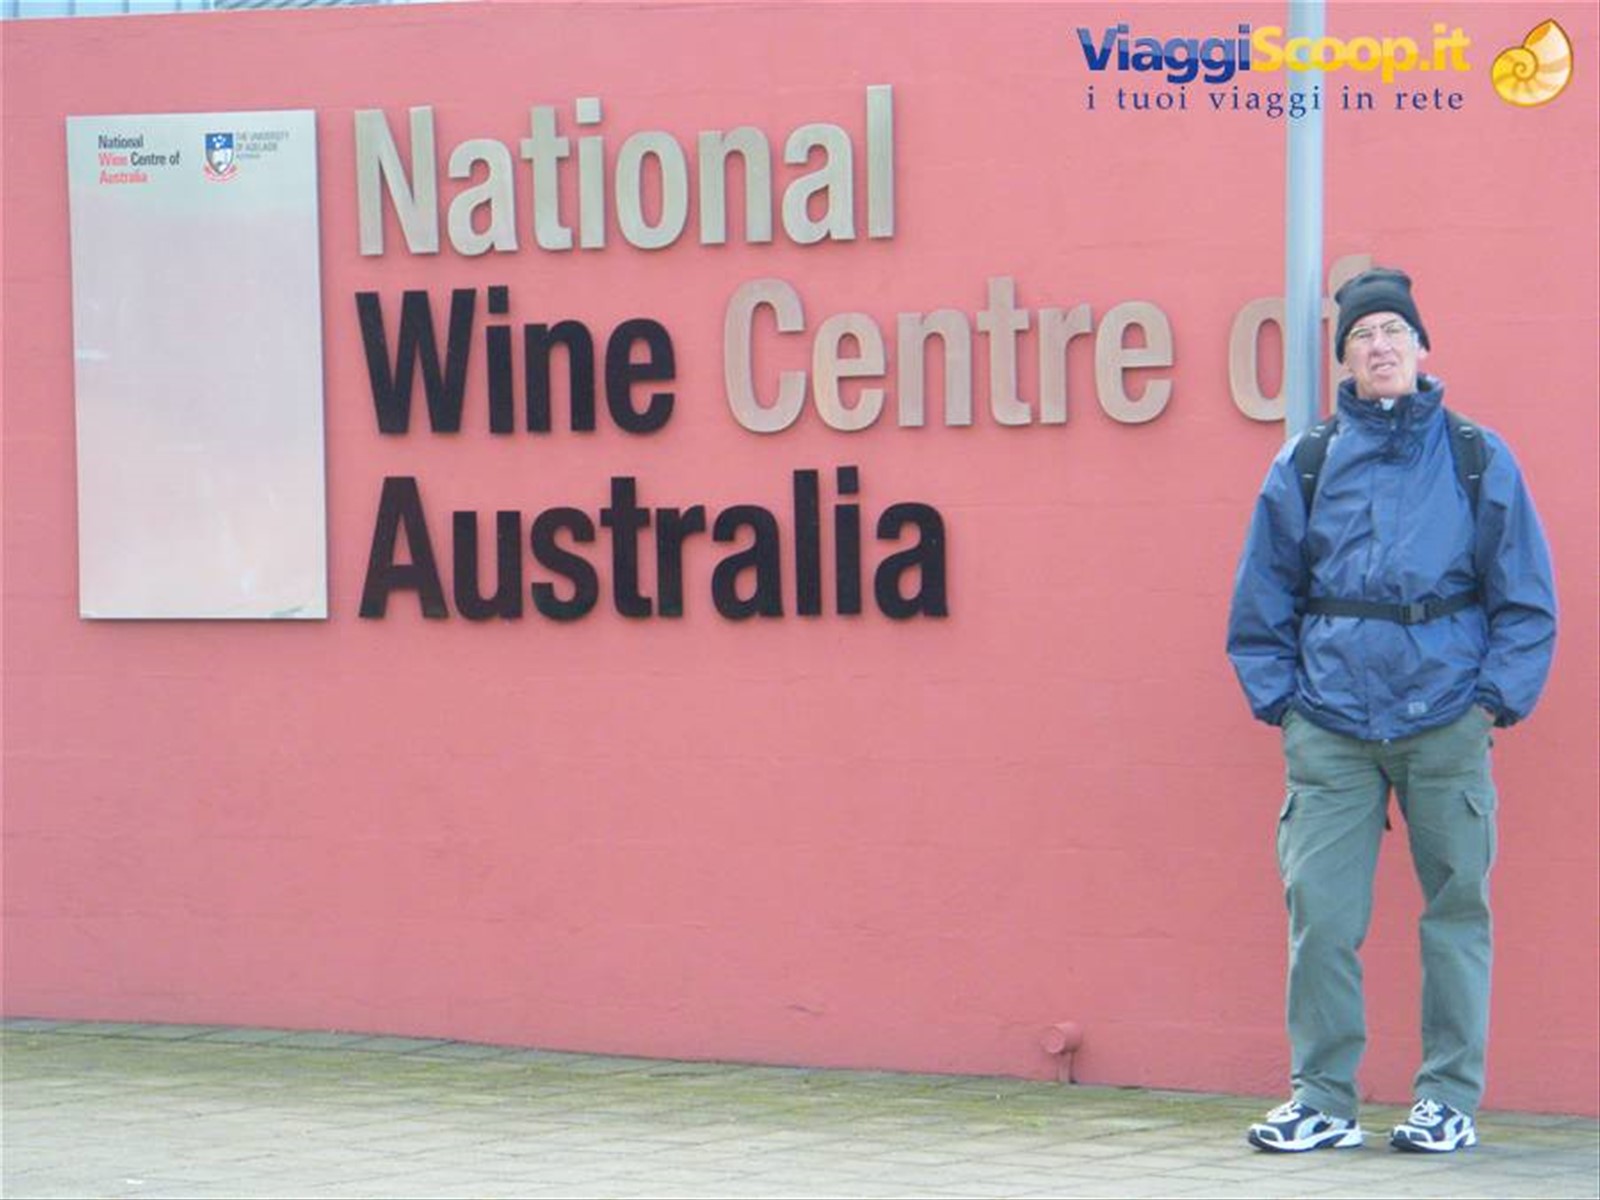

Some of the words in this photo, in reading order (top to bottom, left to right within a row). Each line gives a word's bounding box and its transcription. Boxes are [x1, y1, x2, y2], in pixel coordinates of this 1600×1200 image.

[98, 135, 144, 149] National
[99, 171, 148, 184] Australia
[131, 152, 167, 166] Centre
[169, 151, 180, 165] of
[354, 85, 893, 256] National
[355, 285, 676, 434] Wine
[723, 279, 1173, 433] Centre
[358, 466, 948, 621] Australia
